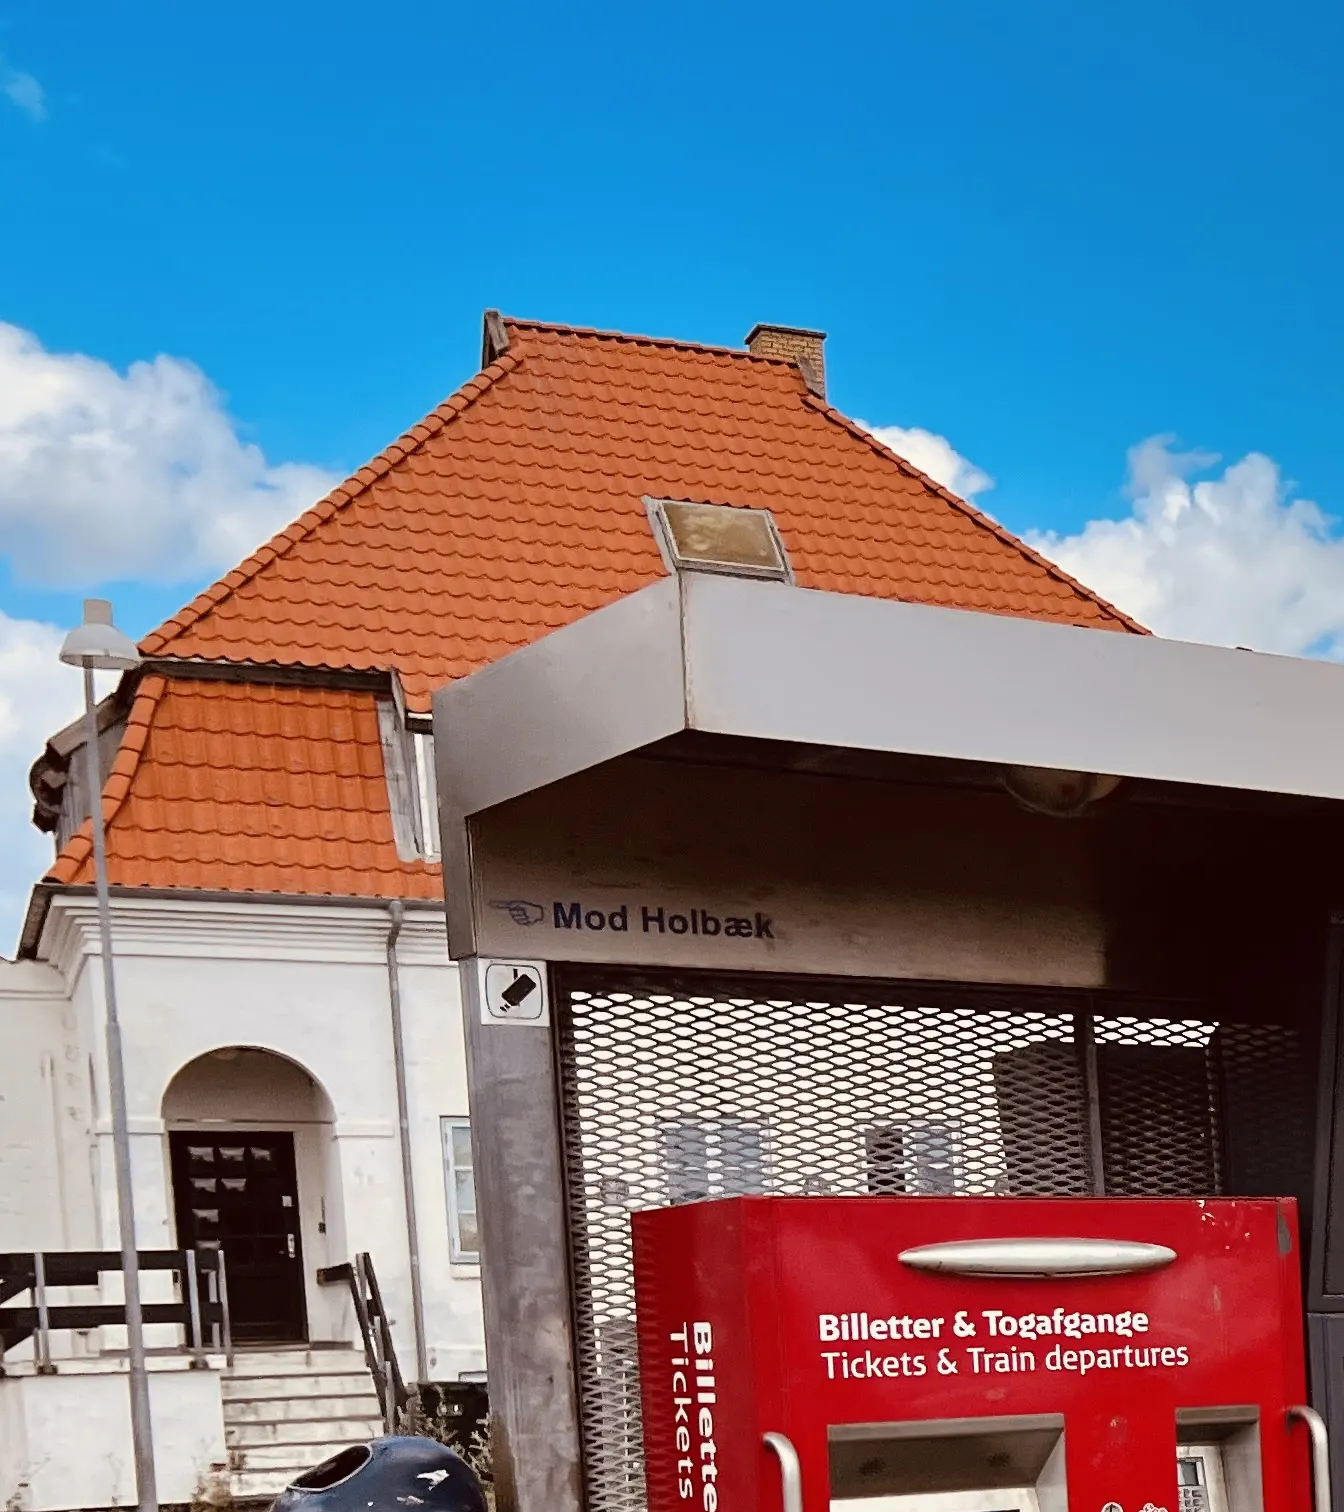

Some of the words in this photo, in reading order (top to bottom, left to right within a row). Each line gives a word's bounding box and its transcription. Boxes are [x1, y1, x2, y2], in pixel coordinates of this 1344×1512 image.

[554, 902, 628, 933] Mod
[641, 906, 776, 940] Holbæk
[818, 1312, 944, 1341] Billetter
[952, 1310, 977, 1338] &
[982, 1306, 1149, 1341] Togafgange
[821, 1350, 926, 1380] Tickets
[936, 1349, 958, 1375] &
[966, 1345, 1035, 1374] Train
[1045, 1341, 1189, 1376] departures
[670, 1322, 693, 1499] Tickets
